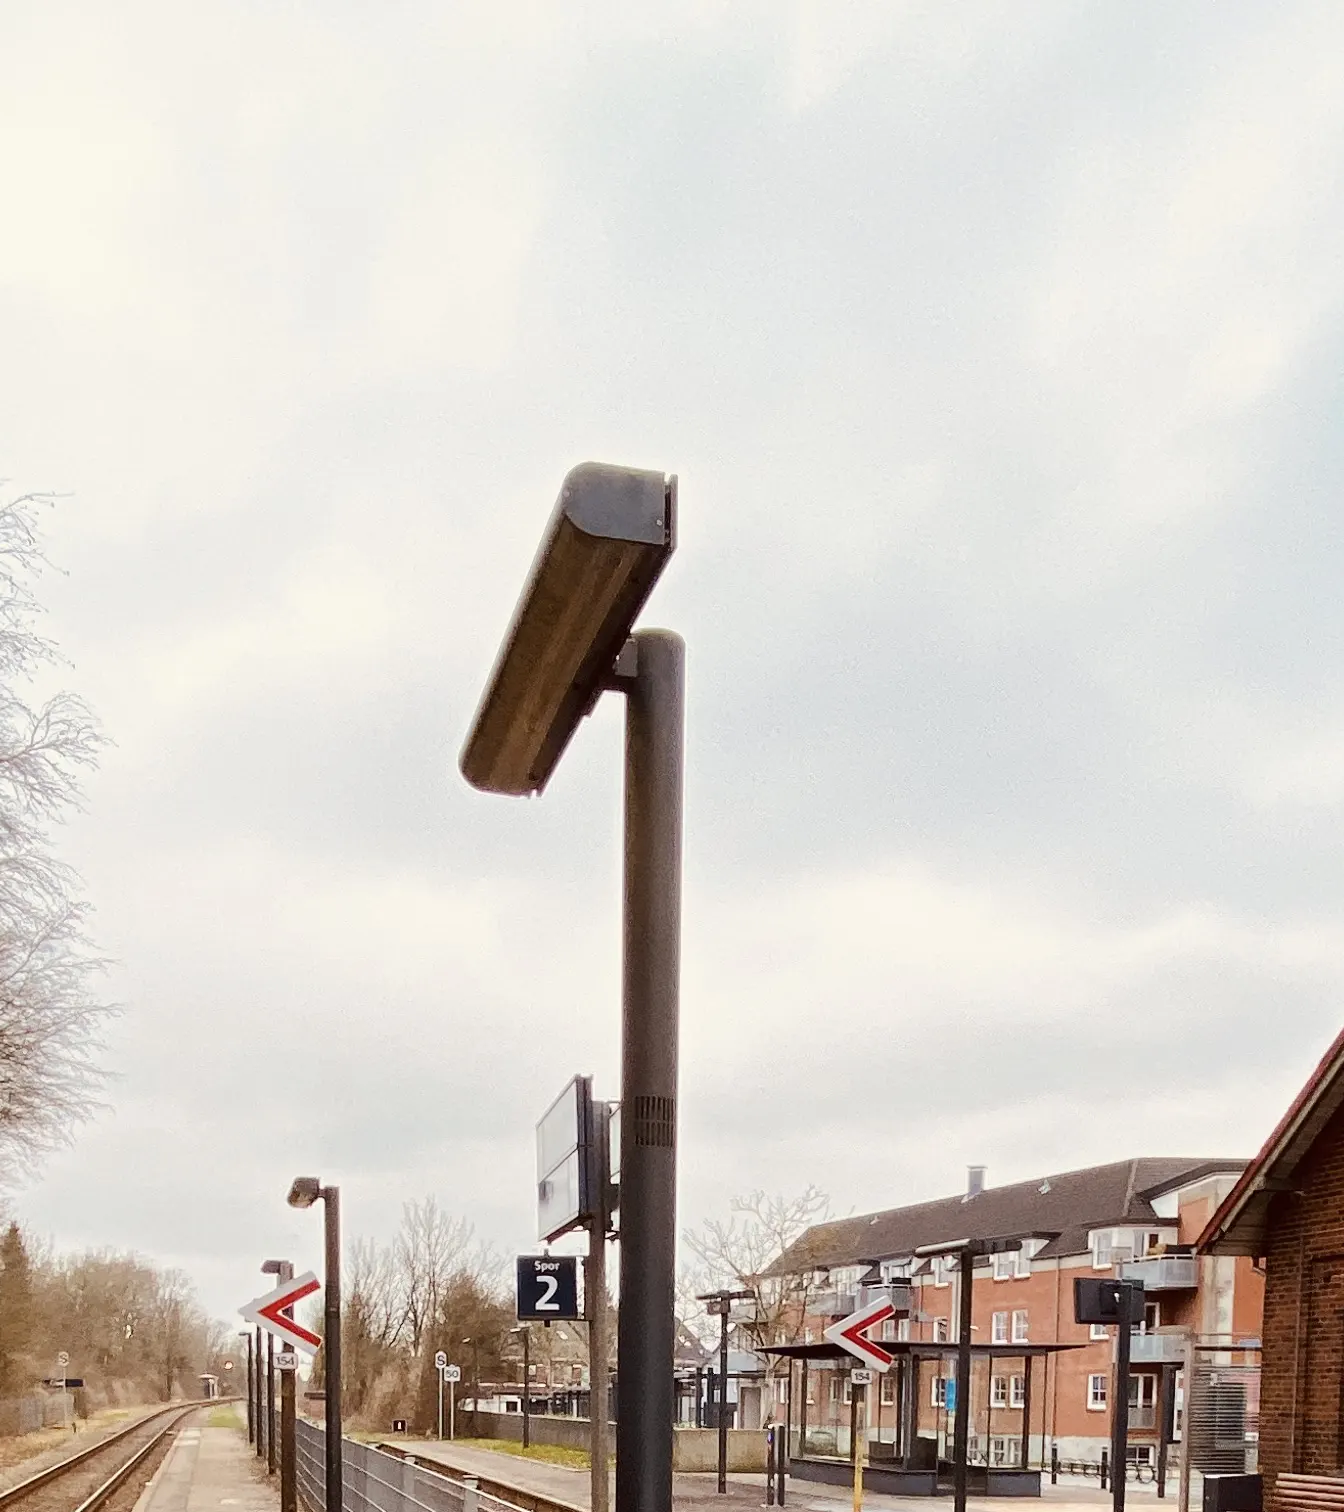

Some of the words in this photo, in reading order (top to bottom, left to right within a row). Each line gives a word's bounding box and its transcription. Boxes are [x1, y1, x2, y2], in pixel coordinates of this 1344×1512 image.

[534, 1260, 560, 1272] Spor
[535, 1275, 560, 1310] 2
[276, 1356, 294, 1366] 154
[437, 1355, 445, 1365] S
[446, 1370, 458, 1378] 50
